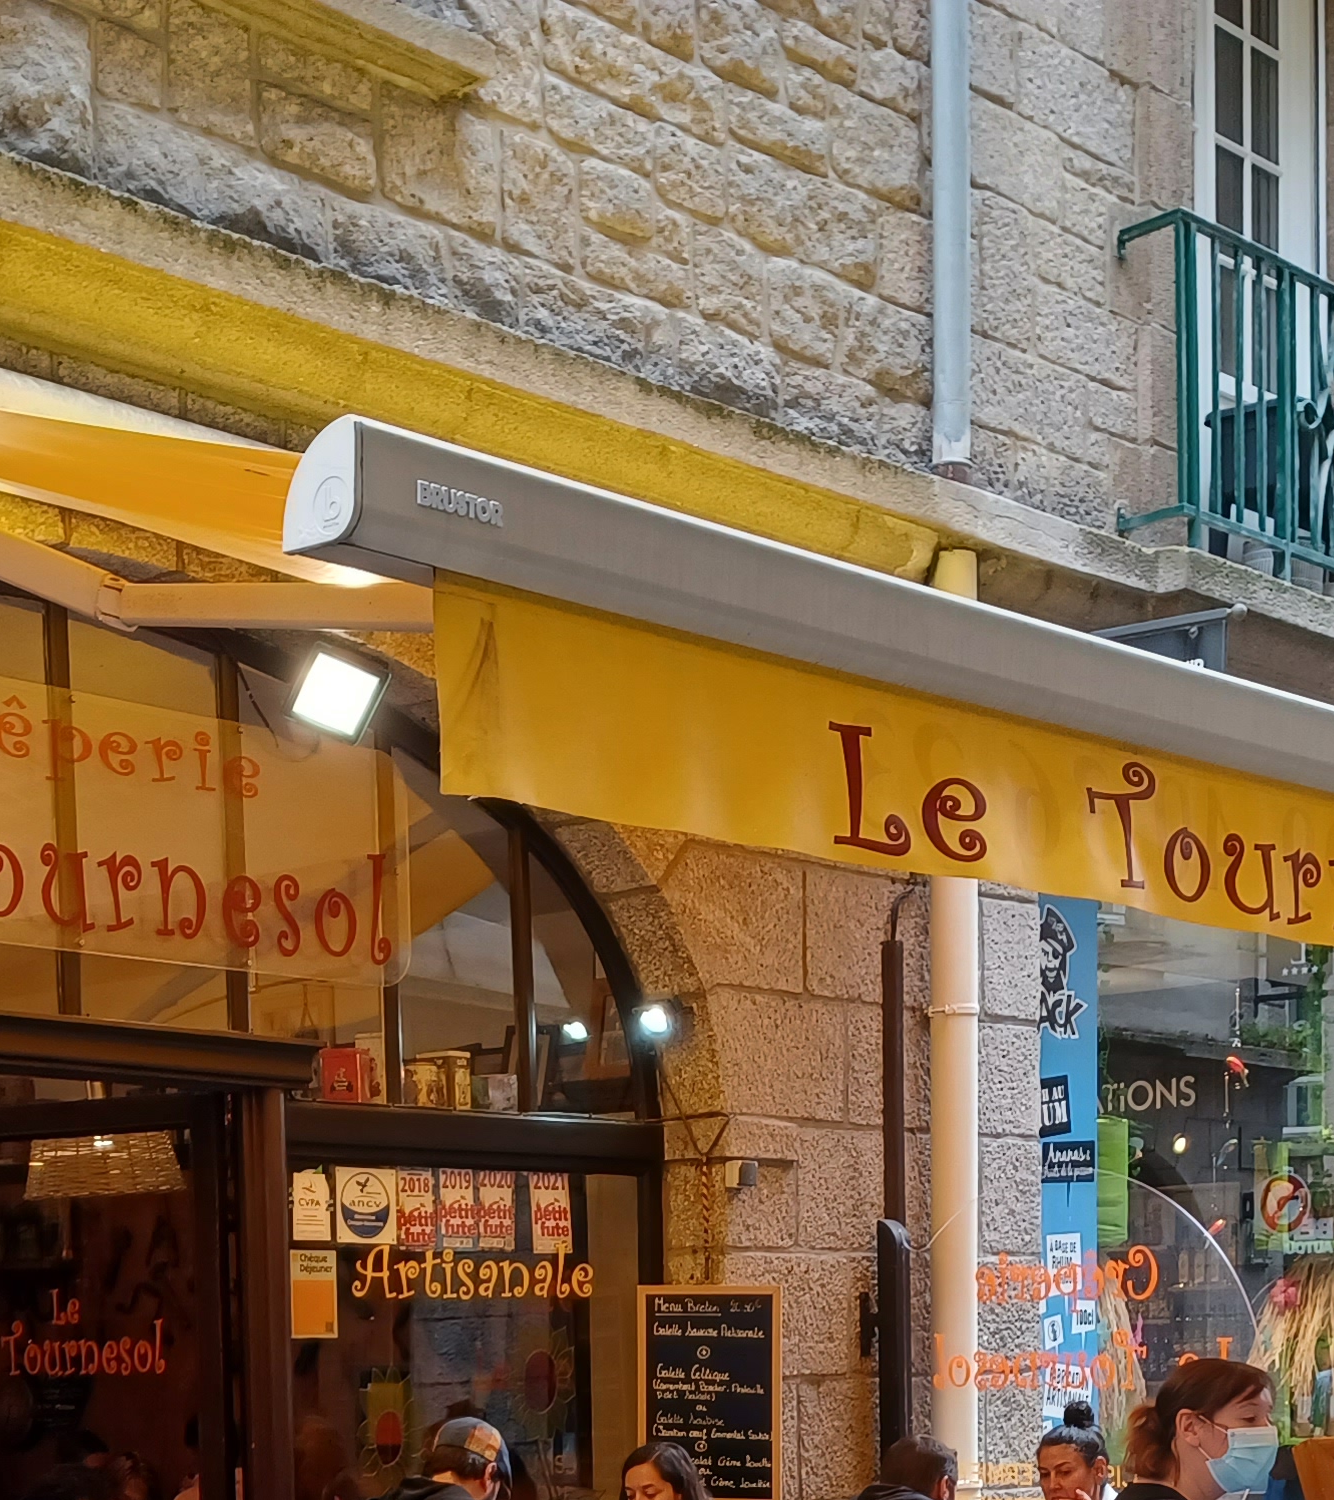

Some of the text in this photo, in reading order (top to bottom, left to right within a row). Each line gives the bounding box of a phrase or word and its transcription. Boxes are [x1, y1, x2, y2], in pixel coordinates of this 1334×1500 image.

[417, 479, 504, 528] BRUSTOR
[827, 720, 988, 863] Le
[1039, 990, 1088, 1040] ACK
[1042, 1100, 1068, 1126] UM
[400, 1177, 430, 1194] 2018
[441, 1170, 471, 1190] 2019
[479, 1170, 514, 1189] 2020
[533, 1173, 566, 1191] 2021
[397, 1208, 436, 1231] petit
[438, 1201, 478, 1222] petit
[477, 1201, 515, 1222] petit
[534, 1203, 569, 1224] petit
[299, 1263, 333, 1275] Déjeuner
[351, 1244, 594, 1300] Artisanale
[49, 1287, 80, 1326] Le
[0, 1318, 166, 1377] Tournesol
